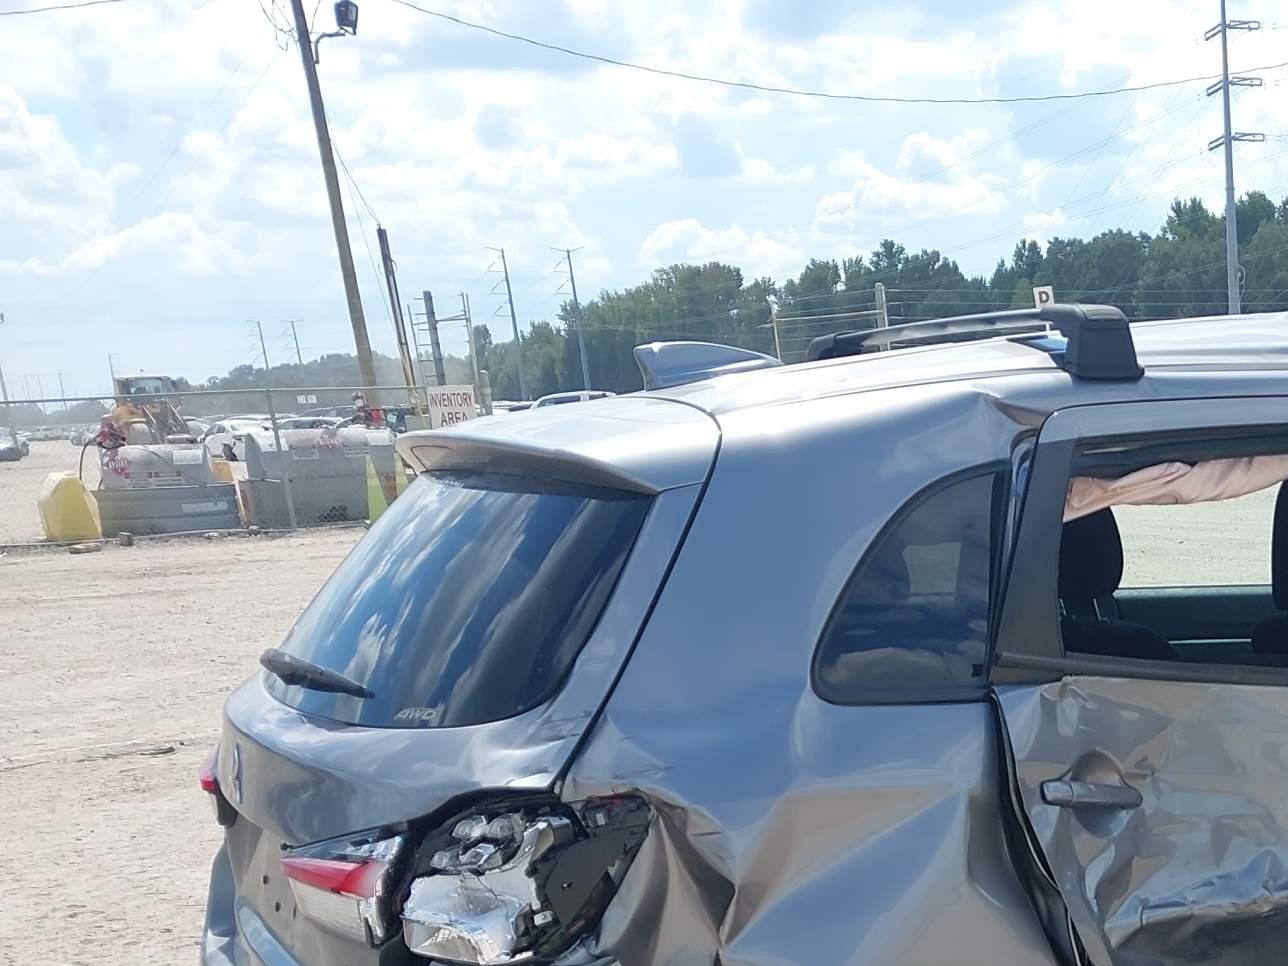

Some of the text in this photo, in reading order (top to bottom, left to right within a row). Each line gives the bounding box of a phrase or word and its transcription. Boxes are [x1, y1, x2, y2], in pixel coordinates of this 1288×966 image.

[1038, 290, 1050, 304] D
[429, 391, 473, 408] INVENTORY
[393, 707, 438, 720] AWD
